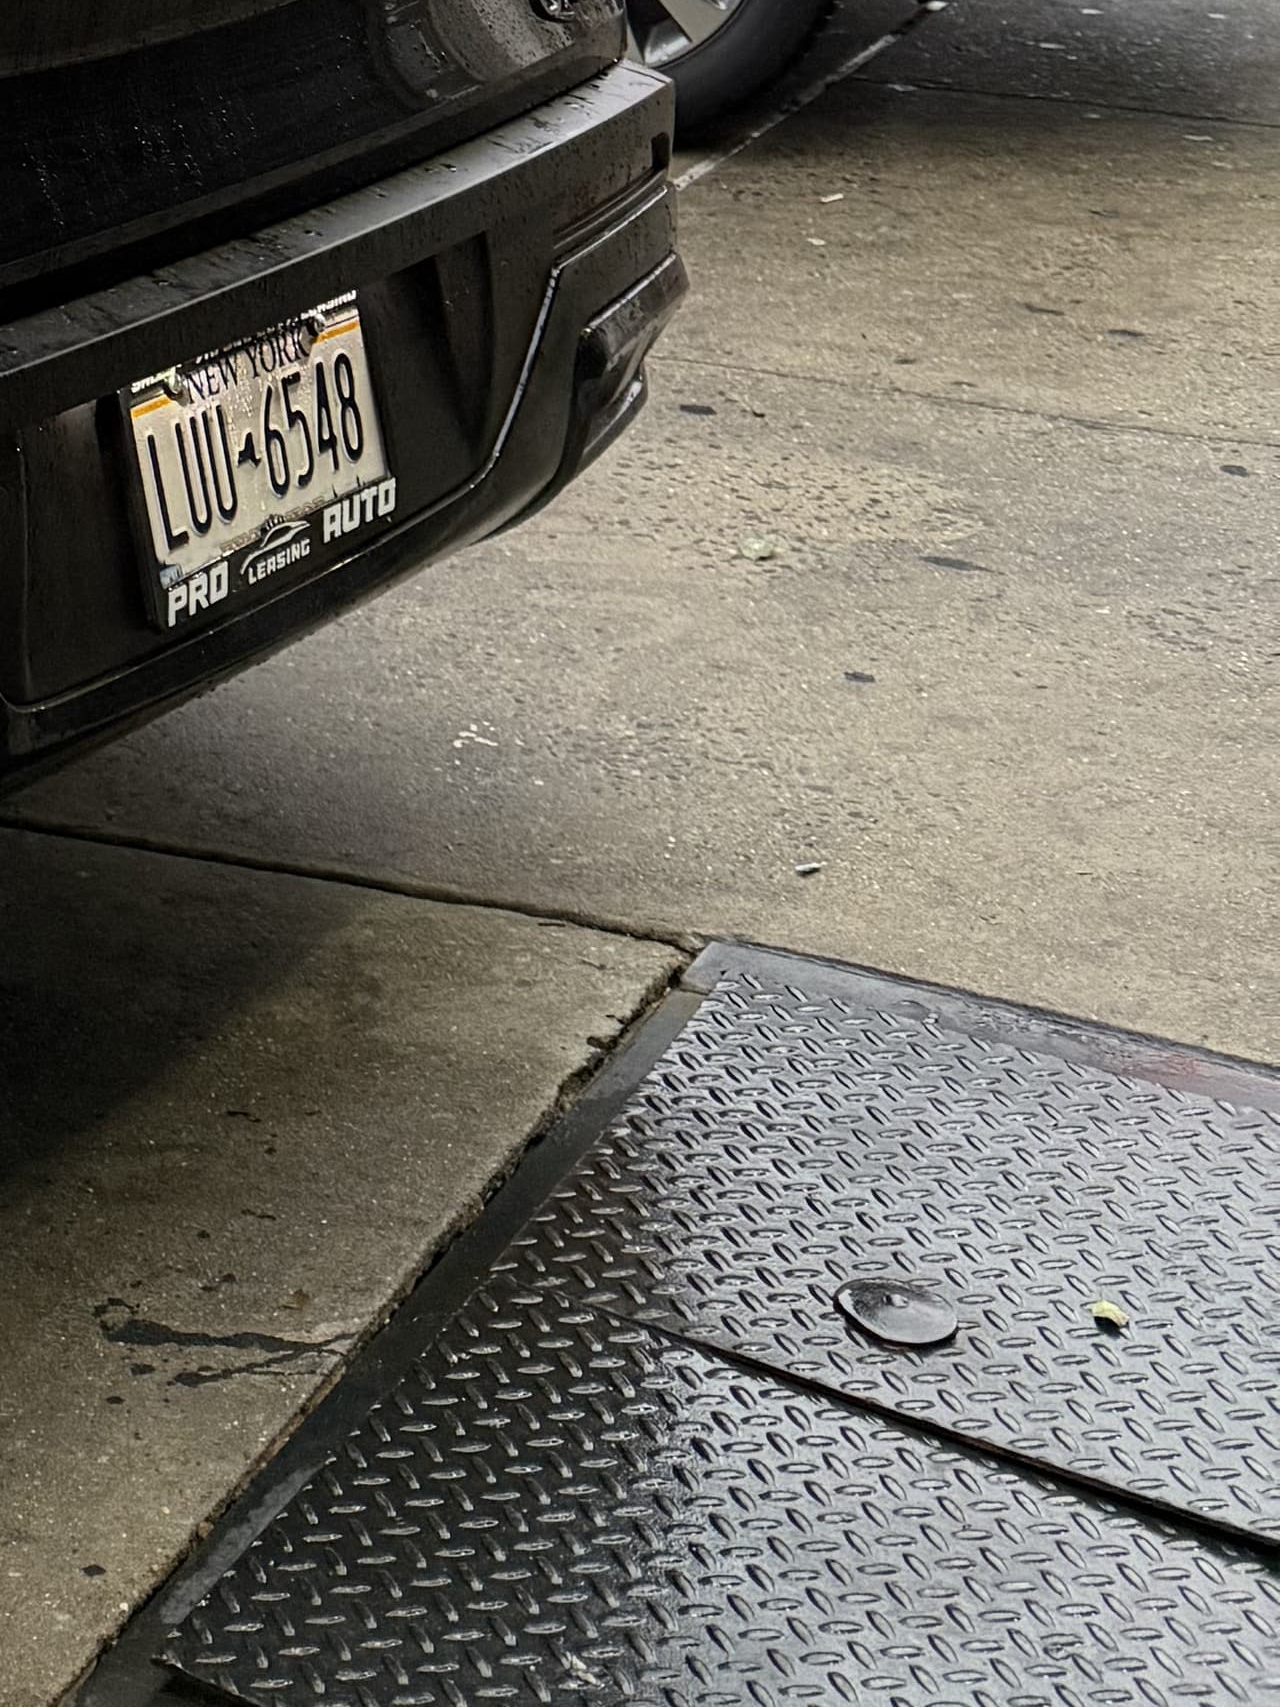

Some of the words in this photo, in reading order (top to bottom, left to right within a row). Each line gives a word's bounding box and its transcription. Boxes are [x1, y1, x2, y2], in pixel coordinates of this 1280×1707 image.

[186, 350, 243, 405] NEW
[240, 324, 313, 380] YORK
[167, 560, 230, 628] PRO
[247, 538, 311, 585] LEASING
[322, 476, 397, 545] AUTO
